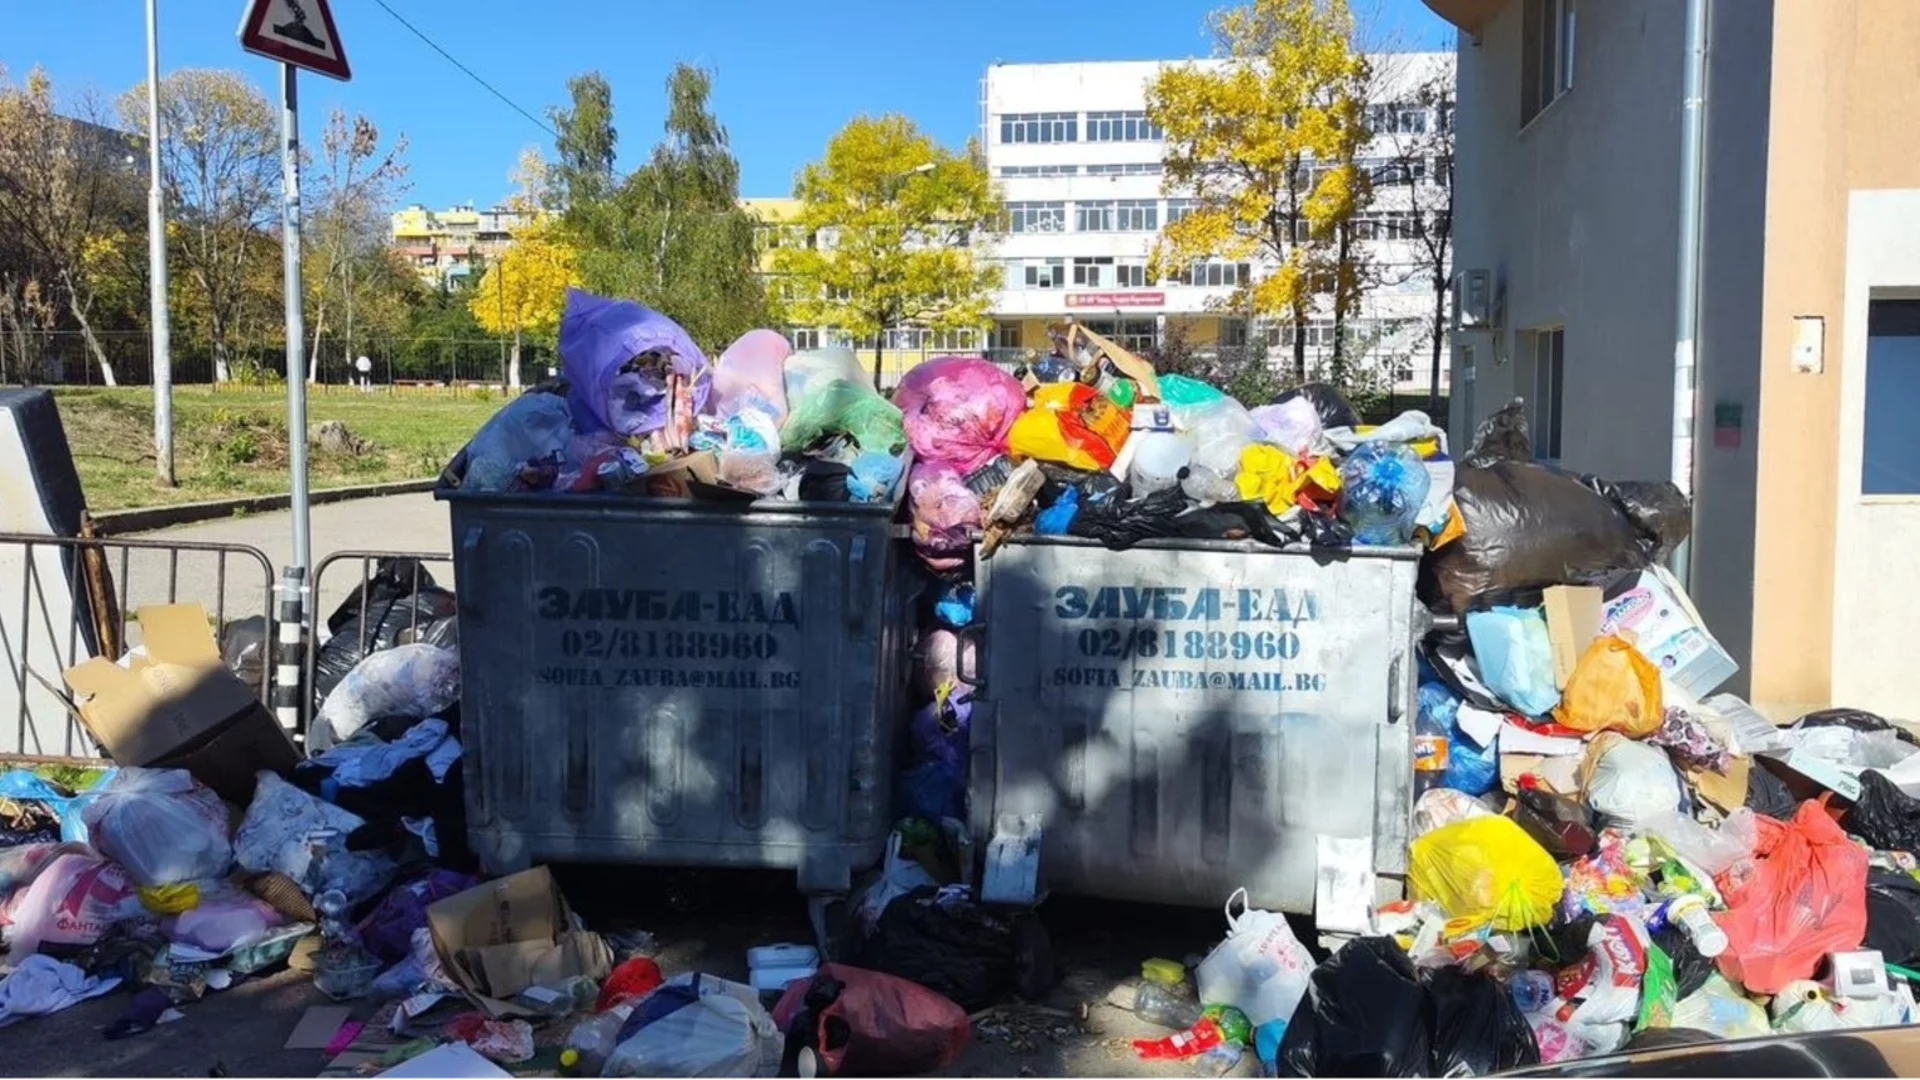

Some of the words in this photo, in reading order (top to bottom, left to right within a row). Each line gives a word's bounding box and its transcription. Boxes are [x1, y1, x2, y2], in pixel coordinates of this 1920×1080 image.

[538, 586, 800, 631] ЗАУБА-ЕАД
[1055, 585, 1321, 629] ЗАУБА-ЕАД
[561, 628, 778, 660] 02/8188960
[1078, 627, 1300, 661] 02/8188960
[1053, 665, 1327, 692] SOFIA_ZAUBA@MAIL.BG
